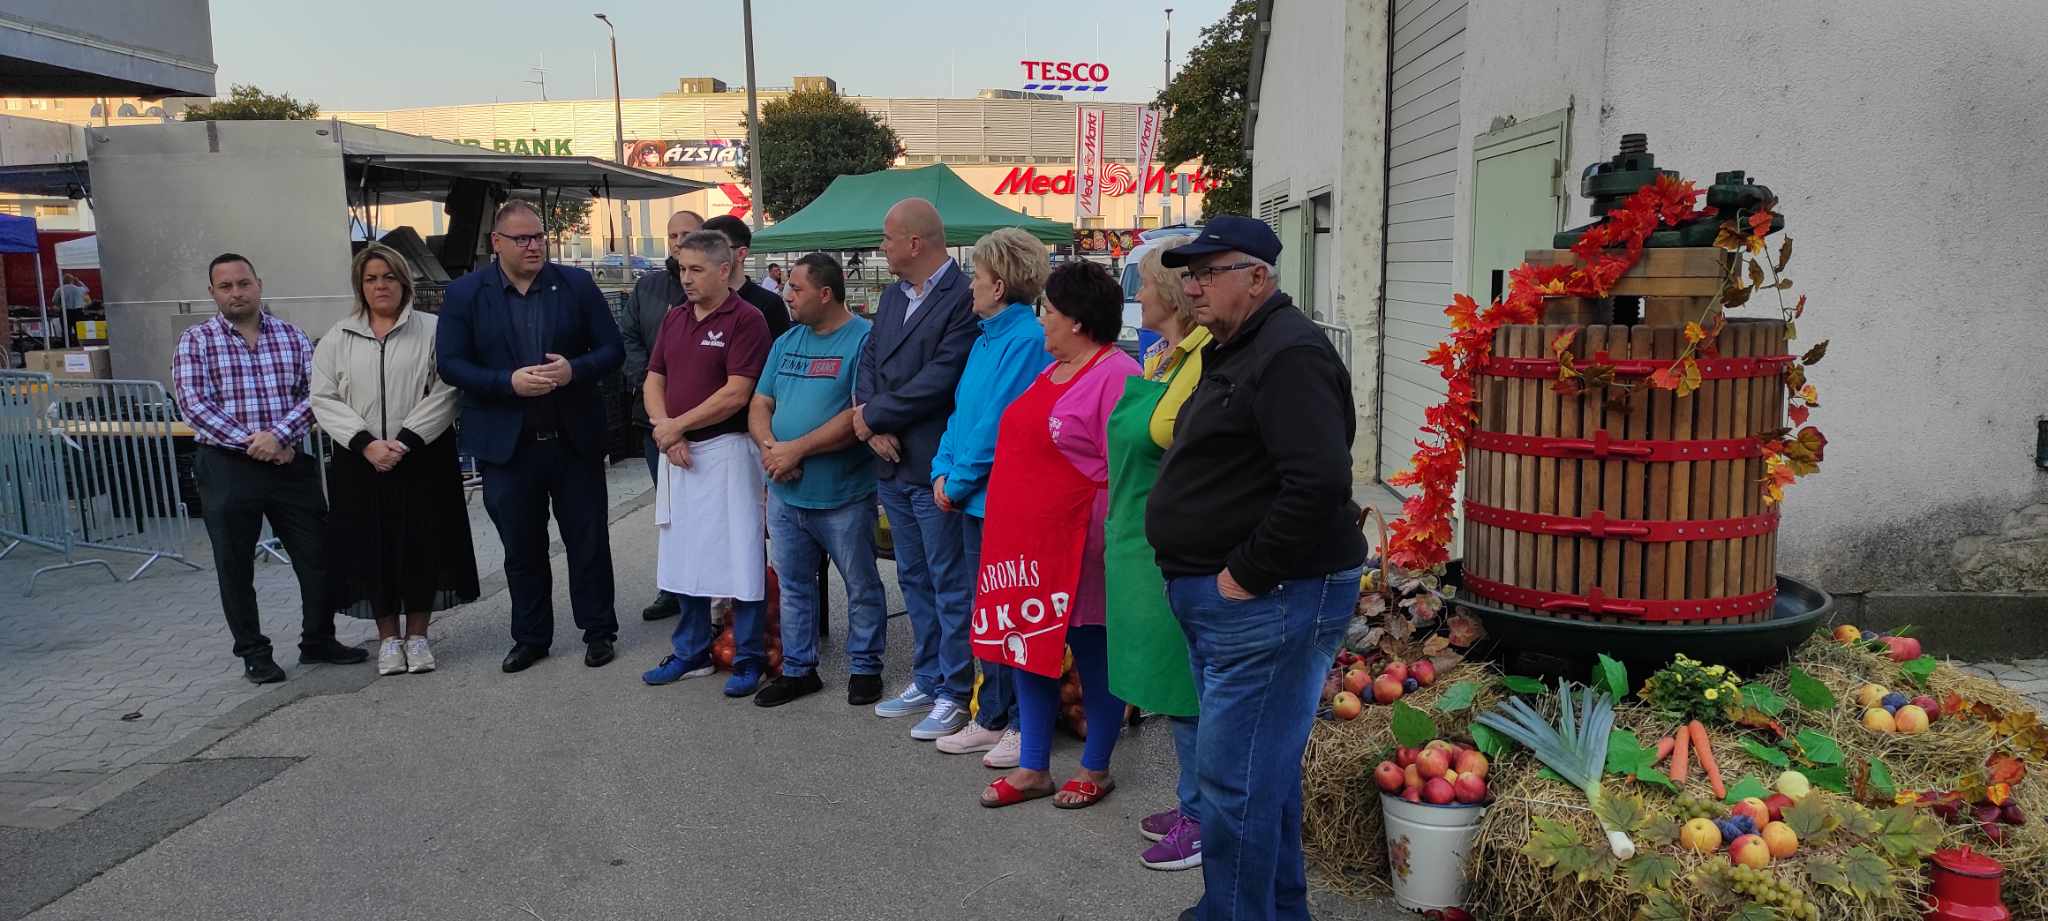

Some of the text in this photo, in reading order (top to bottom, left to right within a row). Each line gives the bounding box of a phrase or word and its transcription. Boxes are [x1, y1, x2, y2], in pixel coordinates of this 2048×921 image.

[1021, 61, 1109, 82] TESCO
[494, 138, 573, 155] BANK
[664, 144, 737, 161] ÁZSIA
[994, 166, 1076, 195] Medi
